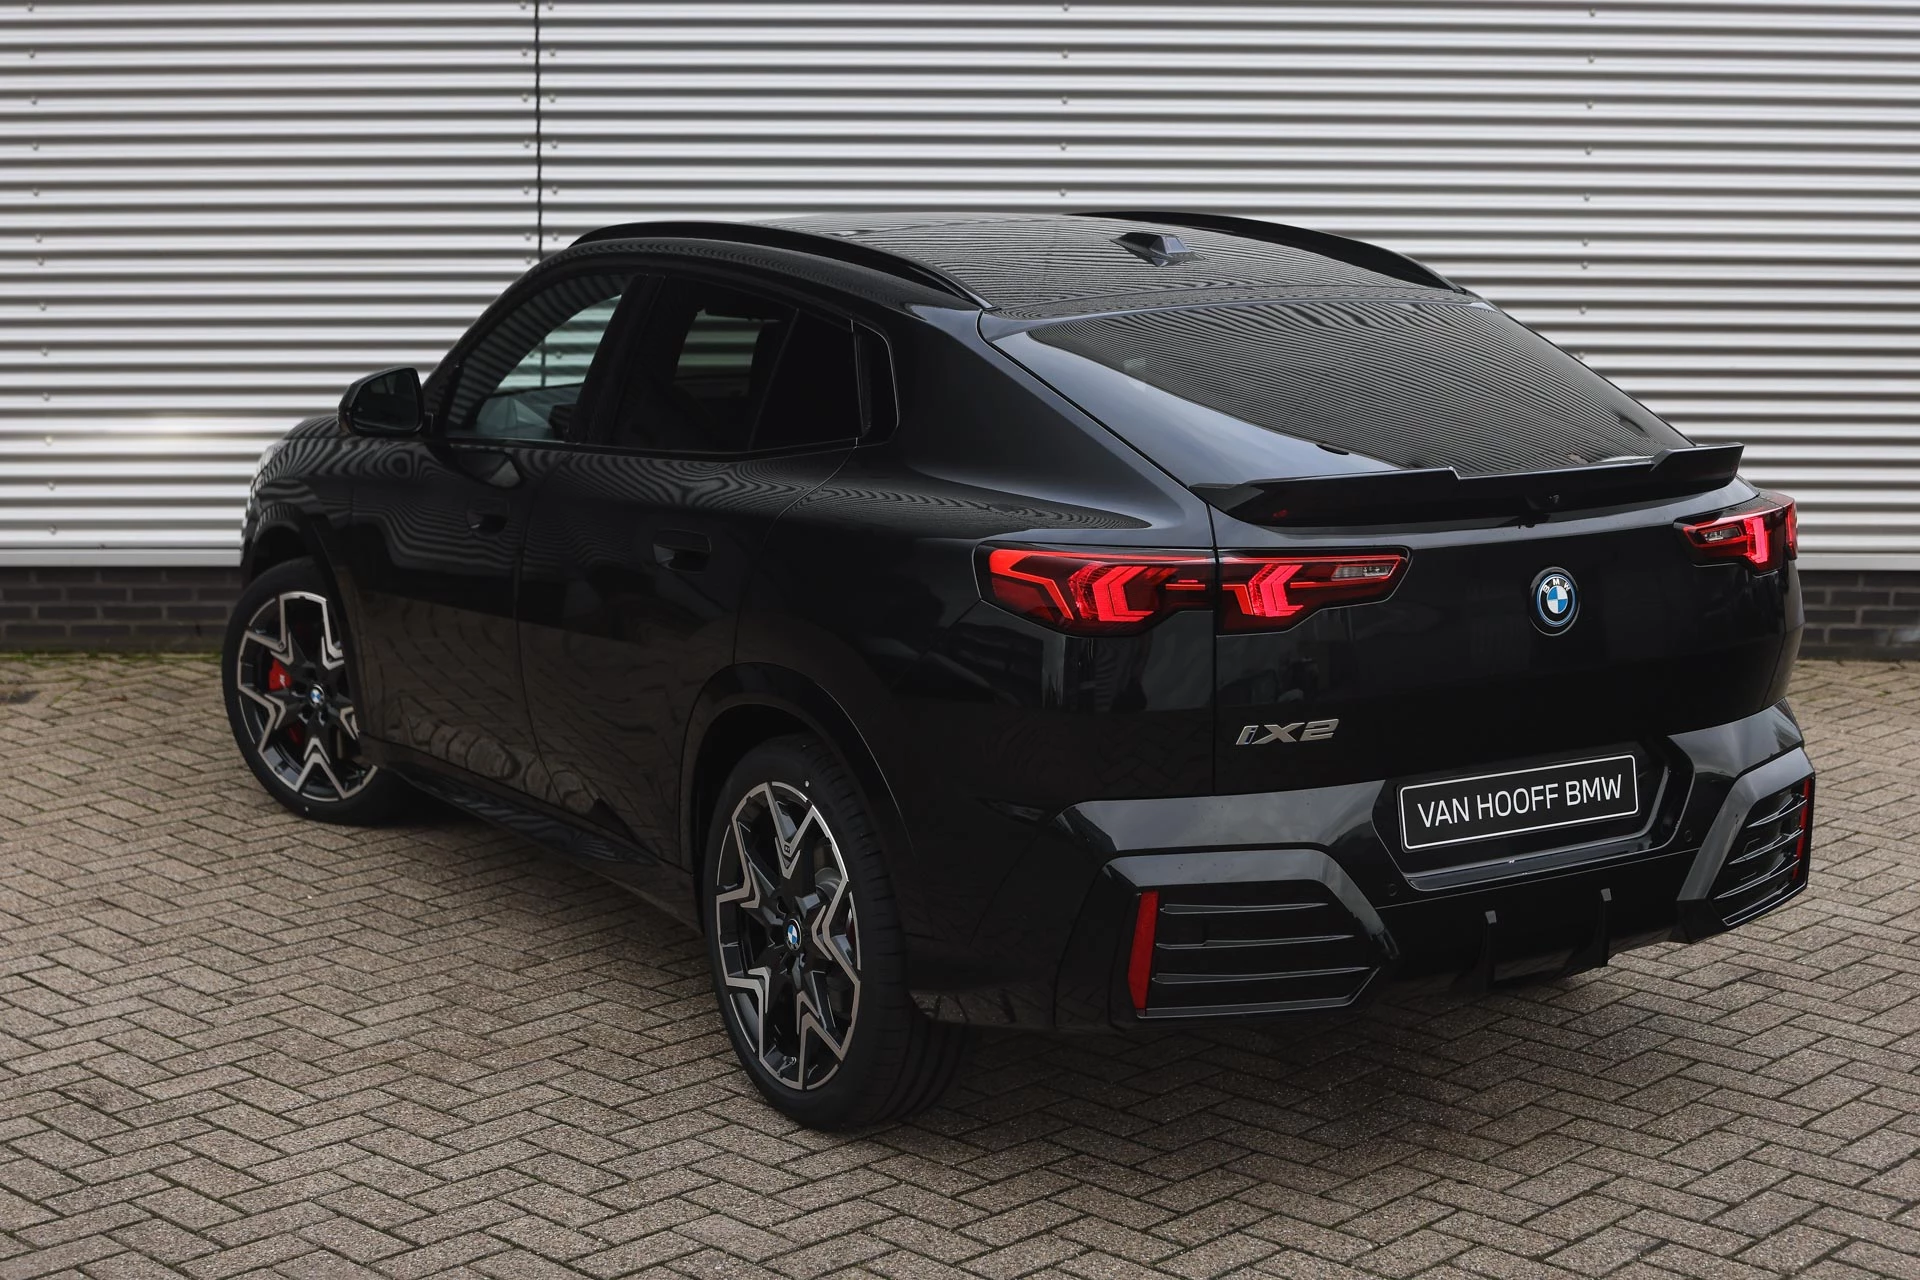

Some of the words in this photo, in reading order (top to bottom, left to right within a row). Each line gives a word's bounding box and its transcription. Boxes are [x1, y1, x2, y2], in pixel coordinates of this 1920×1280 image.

[1542, 578, 1571, 593] BMW
[1417, 796, 1470, 828] VAN
[1476, 783, 1559, 819] HOOFF
[1565, 774, 1622, 806] BMW
